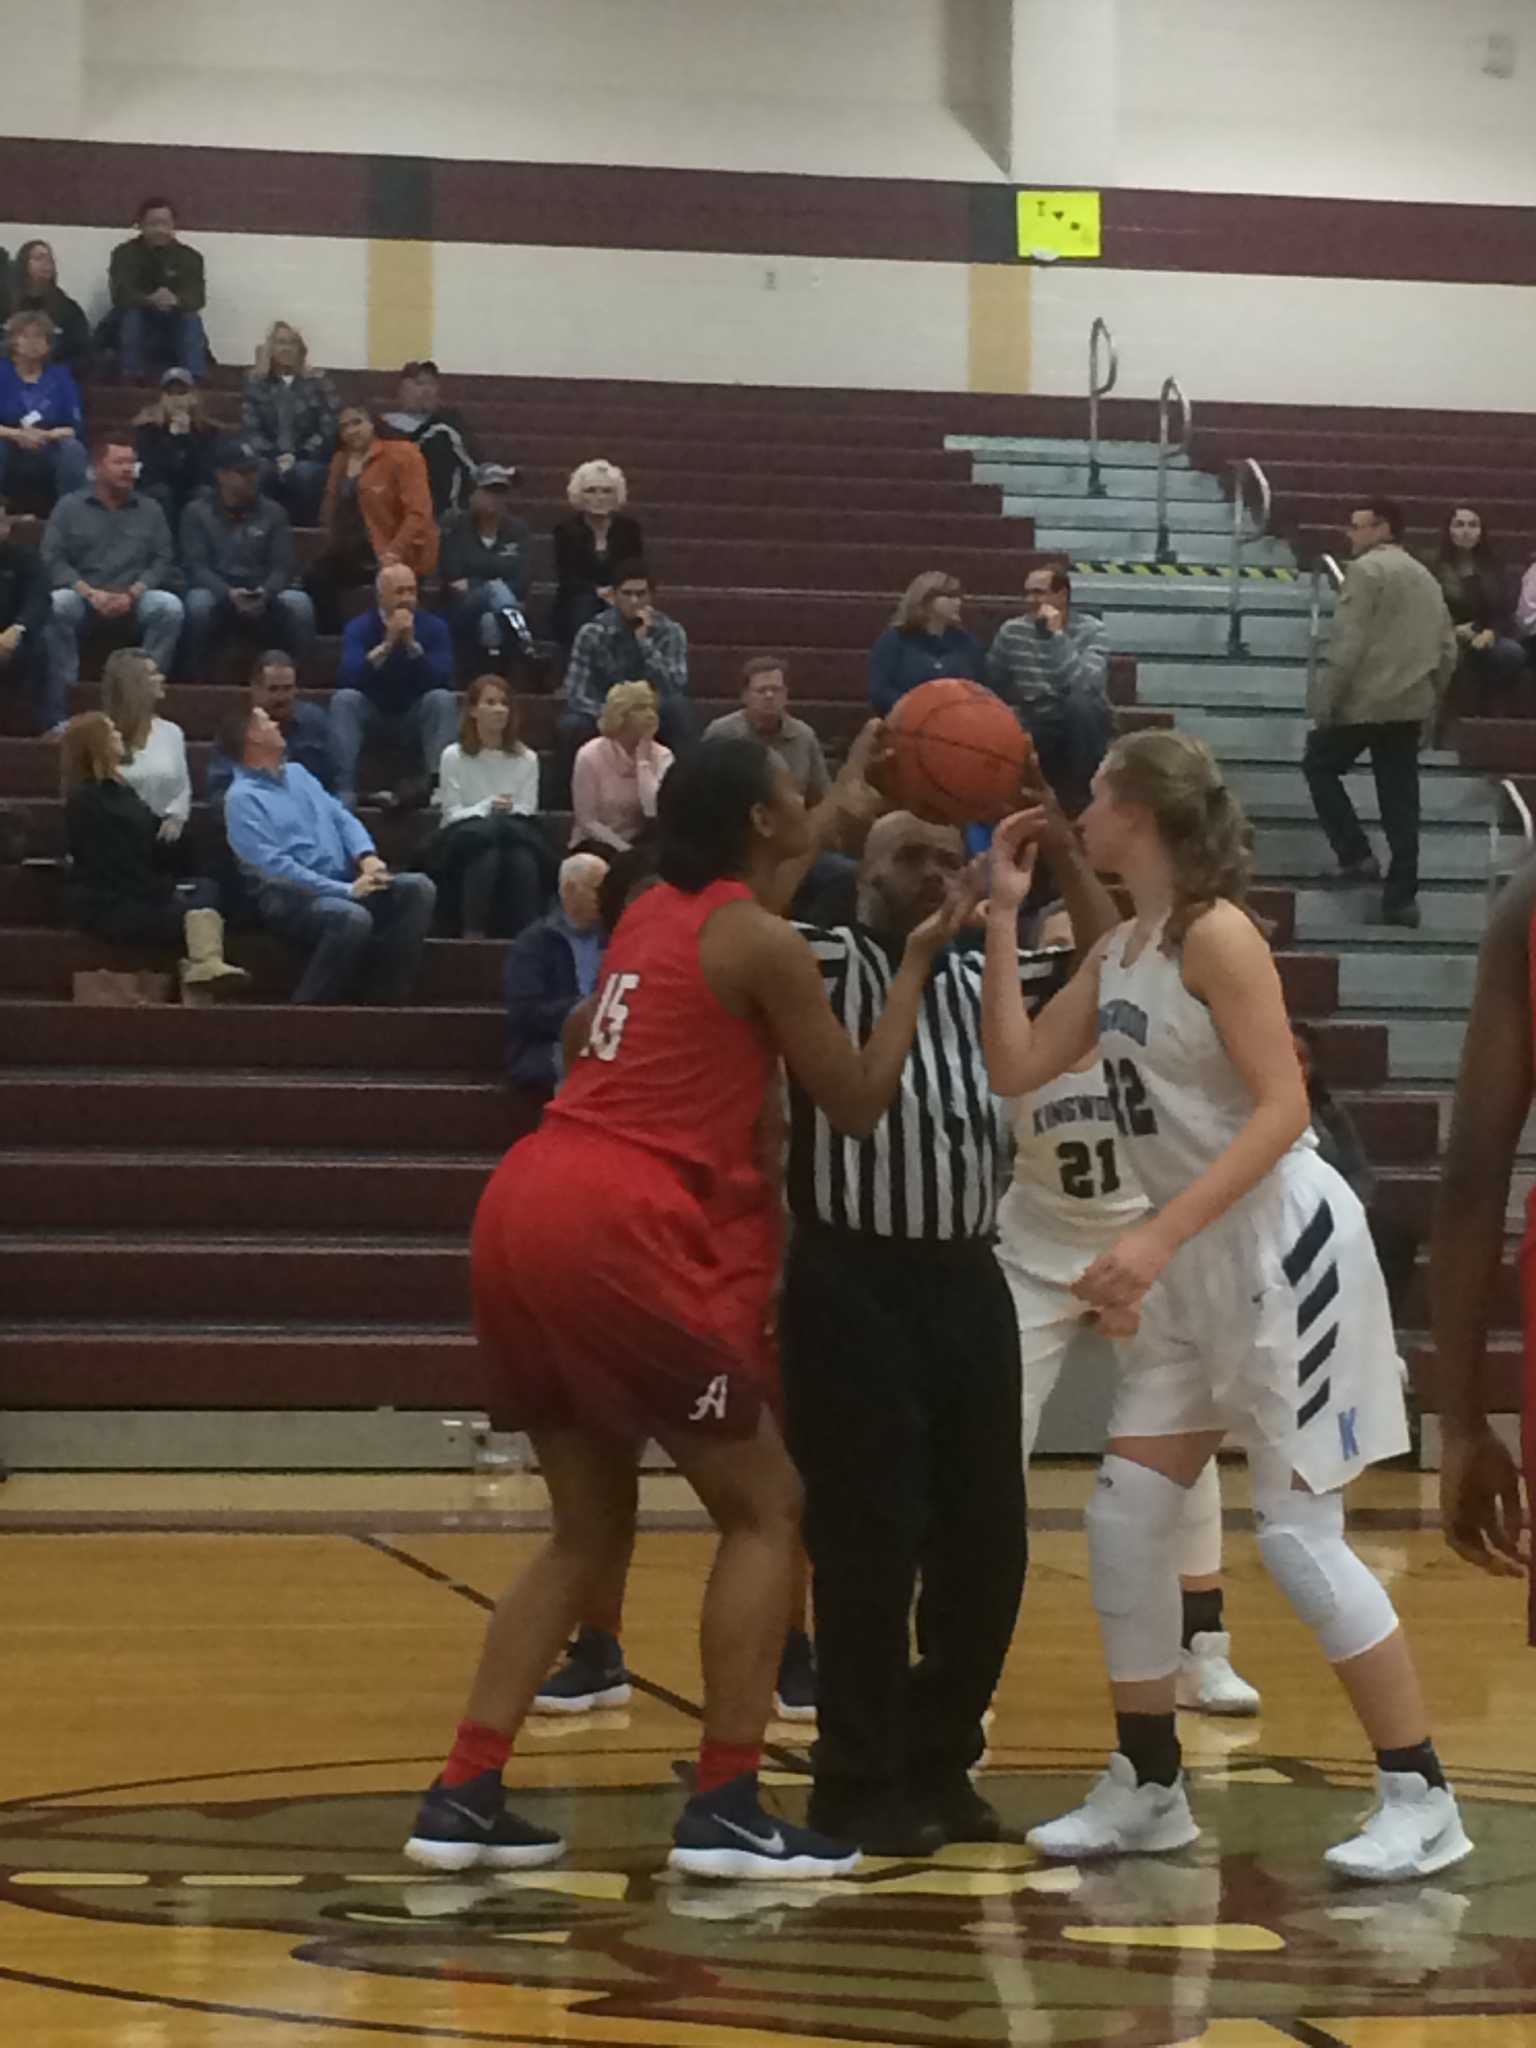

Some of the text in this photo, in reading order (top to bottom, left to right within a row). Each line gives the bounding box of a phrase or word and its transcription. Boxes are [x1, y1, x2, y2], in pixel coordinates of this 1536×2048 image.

[579, 973, 640, 1061] 15
[1103, 1058, 1158, 1136] 12
[1056, 1138, 1120, 1198] 21
[688, 1374, 728, 1420] A
[1336, 1407, 1359, 1461] K
